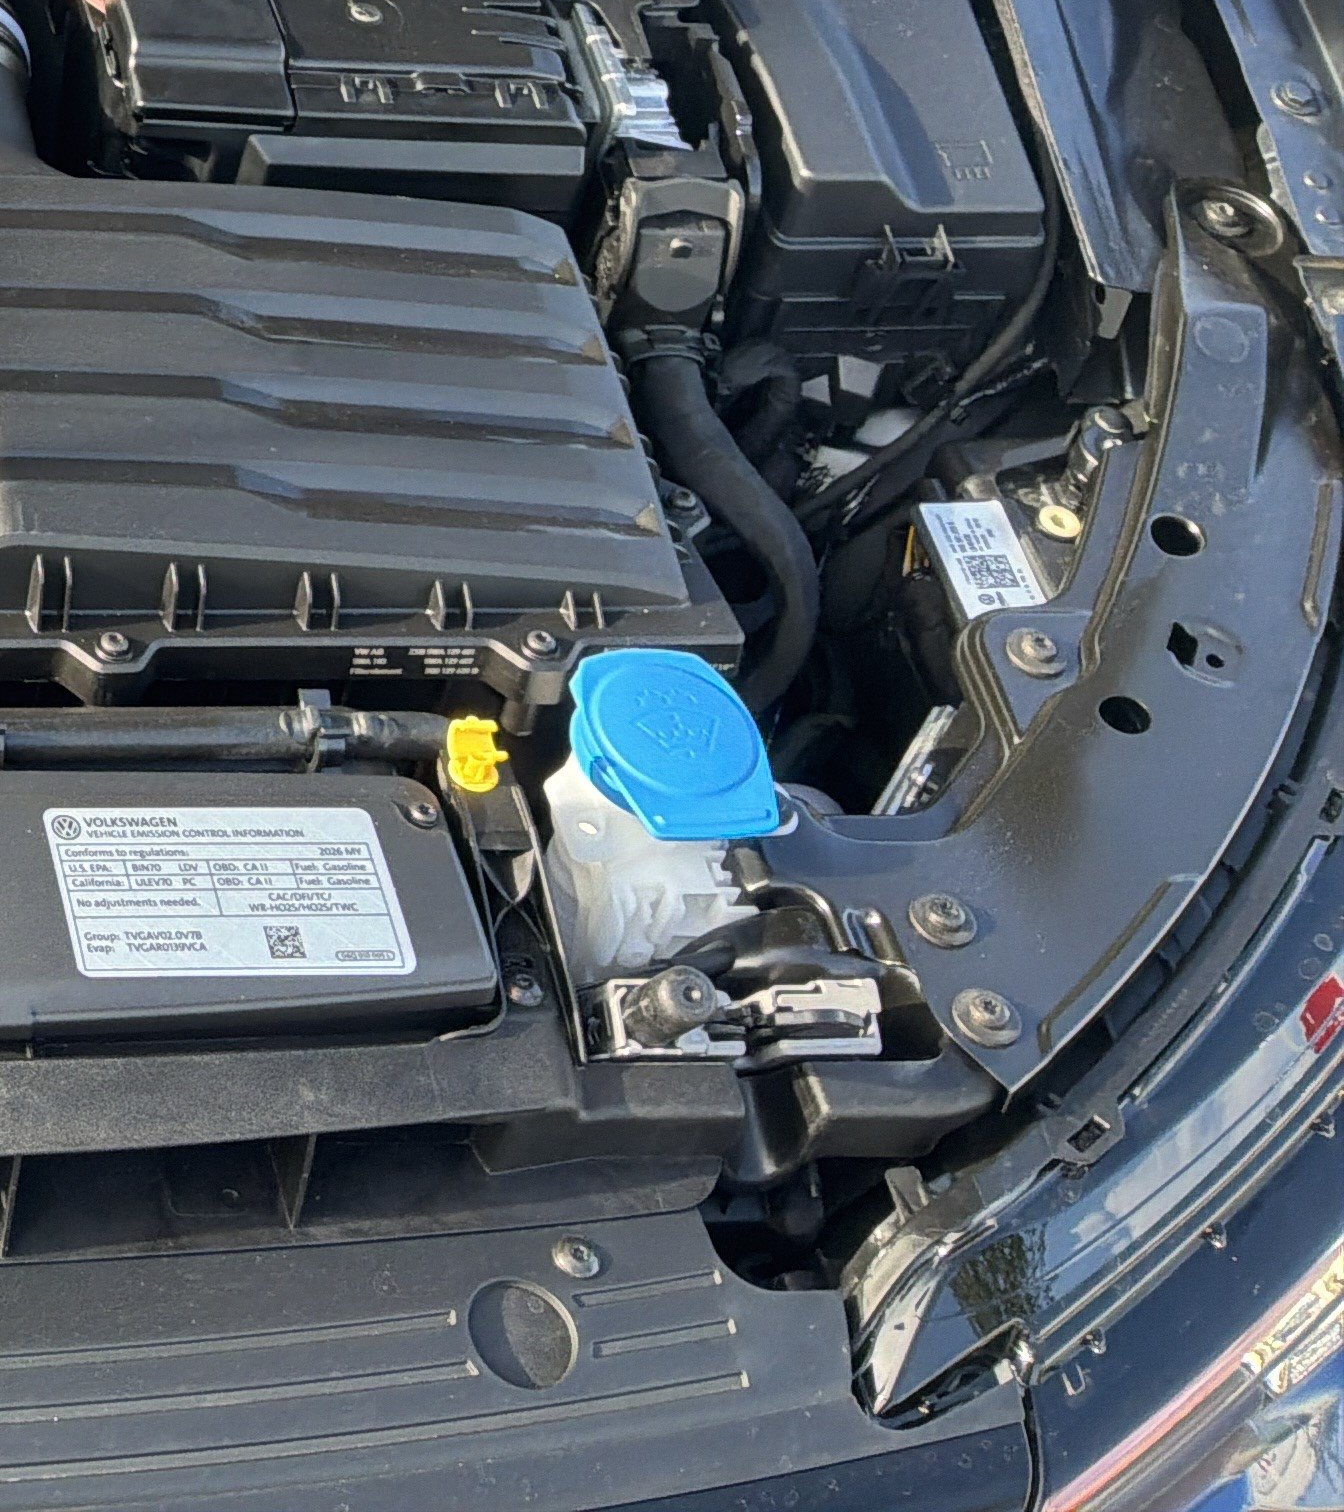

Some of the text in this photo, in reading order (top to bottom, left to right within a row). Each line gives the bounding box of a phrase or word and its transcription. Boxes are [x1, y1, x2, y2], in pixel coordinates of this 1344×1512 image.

[82, 817, 179, 828] VOLKSWAGEN
[85, 828, 305, 839] VEHICLE EMISSION CONTROL INFORMATION
[64, 848, 114, 858] Conforms
[115, 848, 127, 857] to
[317, 847, 362, 856] 2026 MY
[68, 863, 113, 873] U.S. EPA:
[131, 863, 199, 872] BIN70 LDV
[212, 863, 240, 872] OBD:
[242, 863, 259, 871] CA
[294, 862, 367, 872] Fuel: Gasoline
[71, 878, 126, 888] California:
[134, 878, 198, 887] ULEV70 PC
[216, 877, 244, 886] OBD:
[247, 877, 264, 886] CA
[298, 876, 372, 886] Fuel: Gasoline
[76, 897, 202, 910] No adjustments needed.
[83, 931, 121, 942] Group:
[87, 943, 116, 953] Evap:
